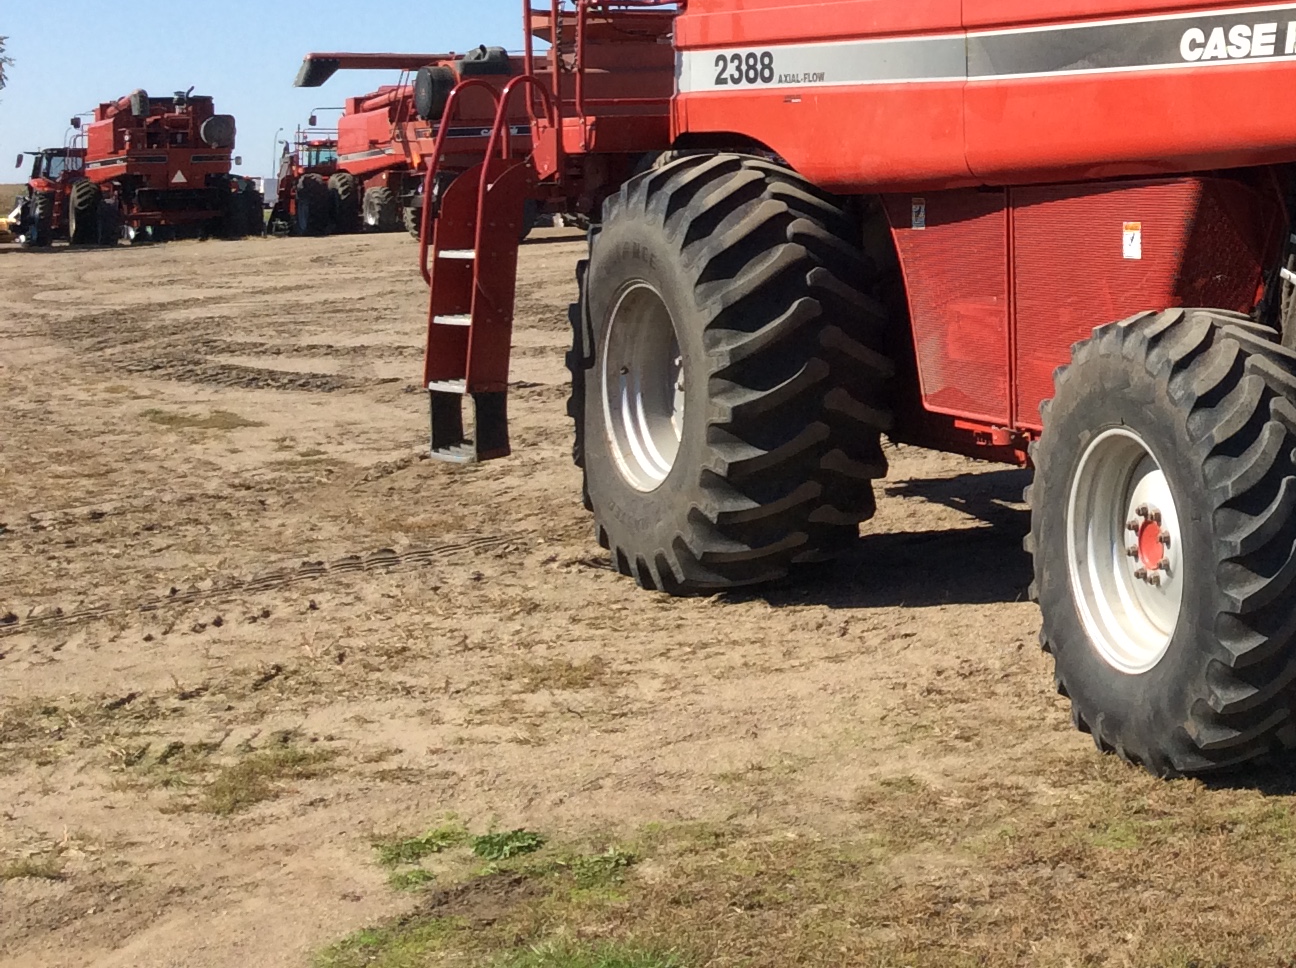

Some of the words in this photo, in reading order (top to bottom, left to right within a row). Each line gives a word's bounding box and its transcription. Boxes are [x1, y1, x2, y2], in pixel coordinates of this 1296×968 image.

[1180, 22, 1277, 61] CASE
[714, 51, 774, 85] 2388
[777, 72, 825, 84] AXIAL-FLOW
